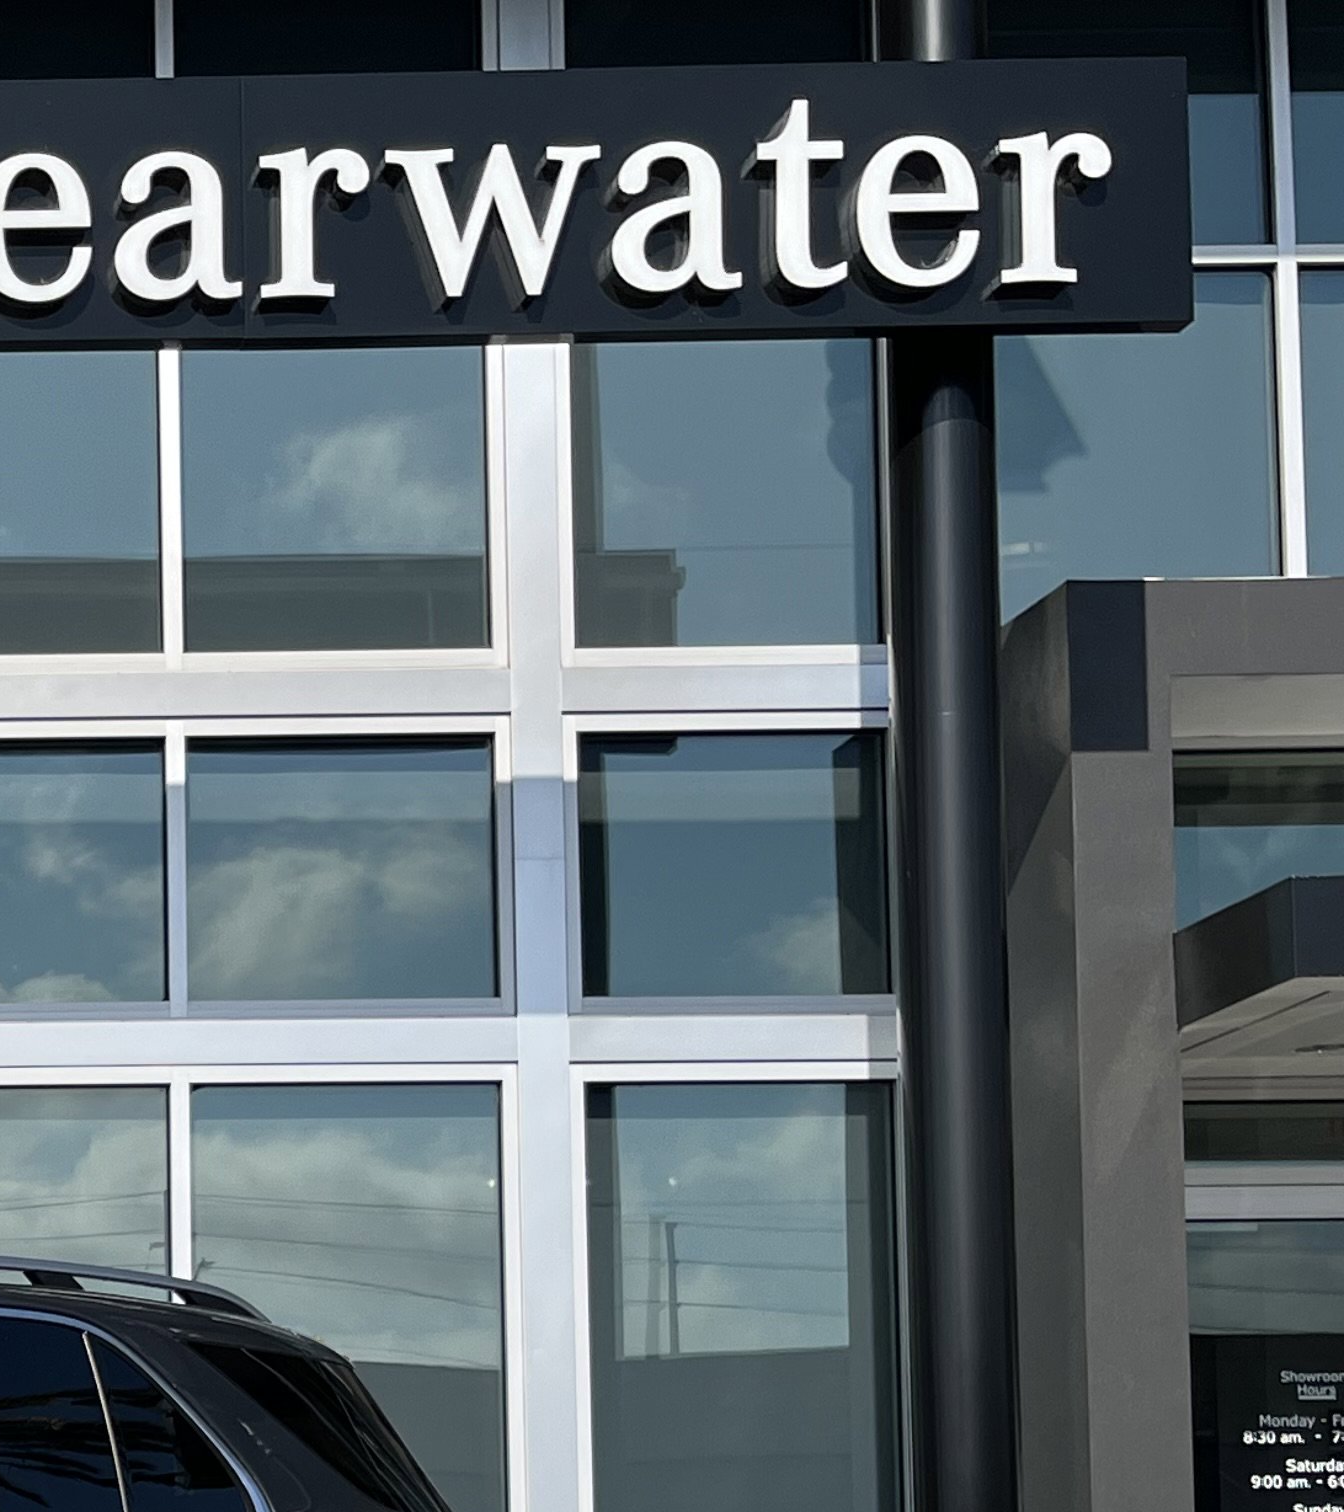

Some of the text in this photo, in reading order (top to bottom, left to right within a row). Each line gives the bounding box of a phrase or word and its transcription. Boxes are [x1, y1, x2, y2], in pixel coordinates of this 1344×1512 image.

[1297, 1384, 1336, 1396] Hours
[1259, 1414, 1316, 1429] Monday
[1243, 1431, 1276, 1444] 8:30
[1280, 1433, 1305, 1444] am.
[1250, 1475, 1283, 1489] 9:00
[1286, 1477, 1311, 1489] am.
